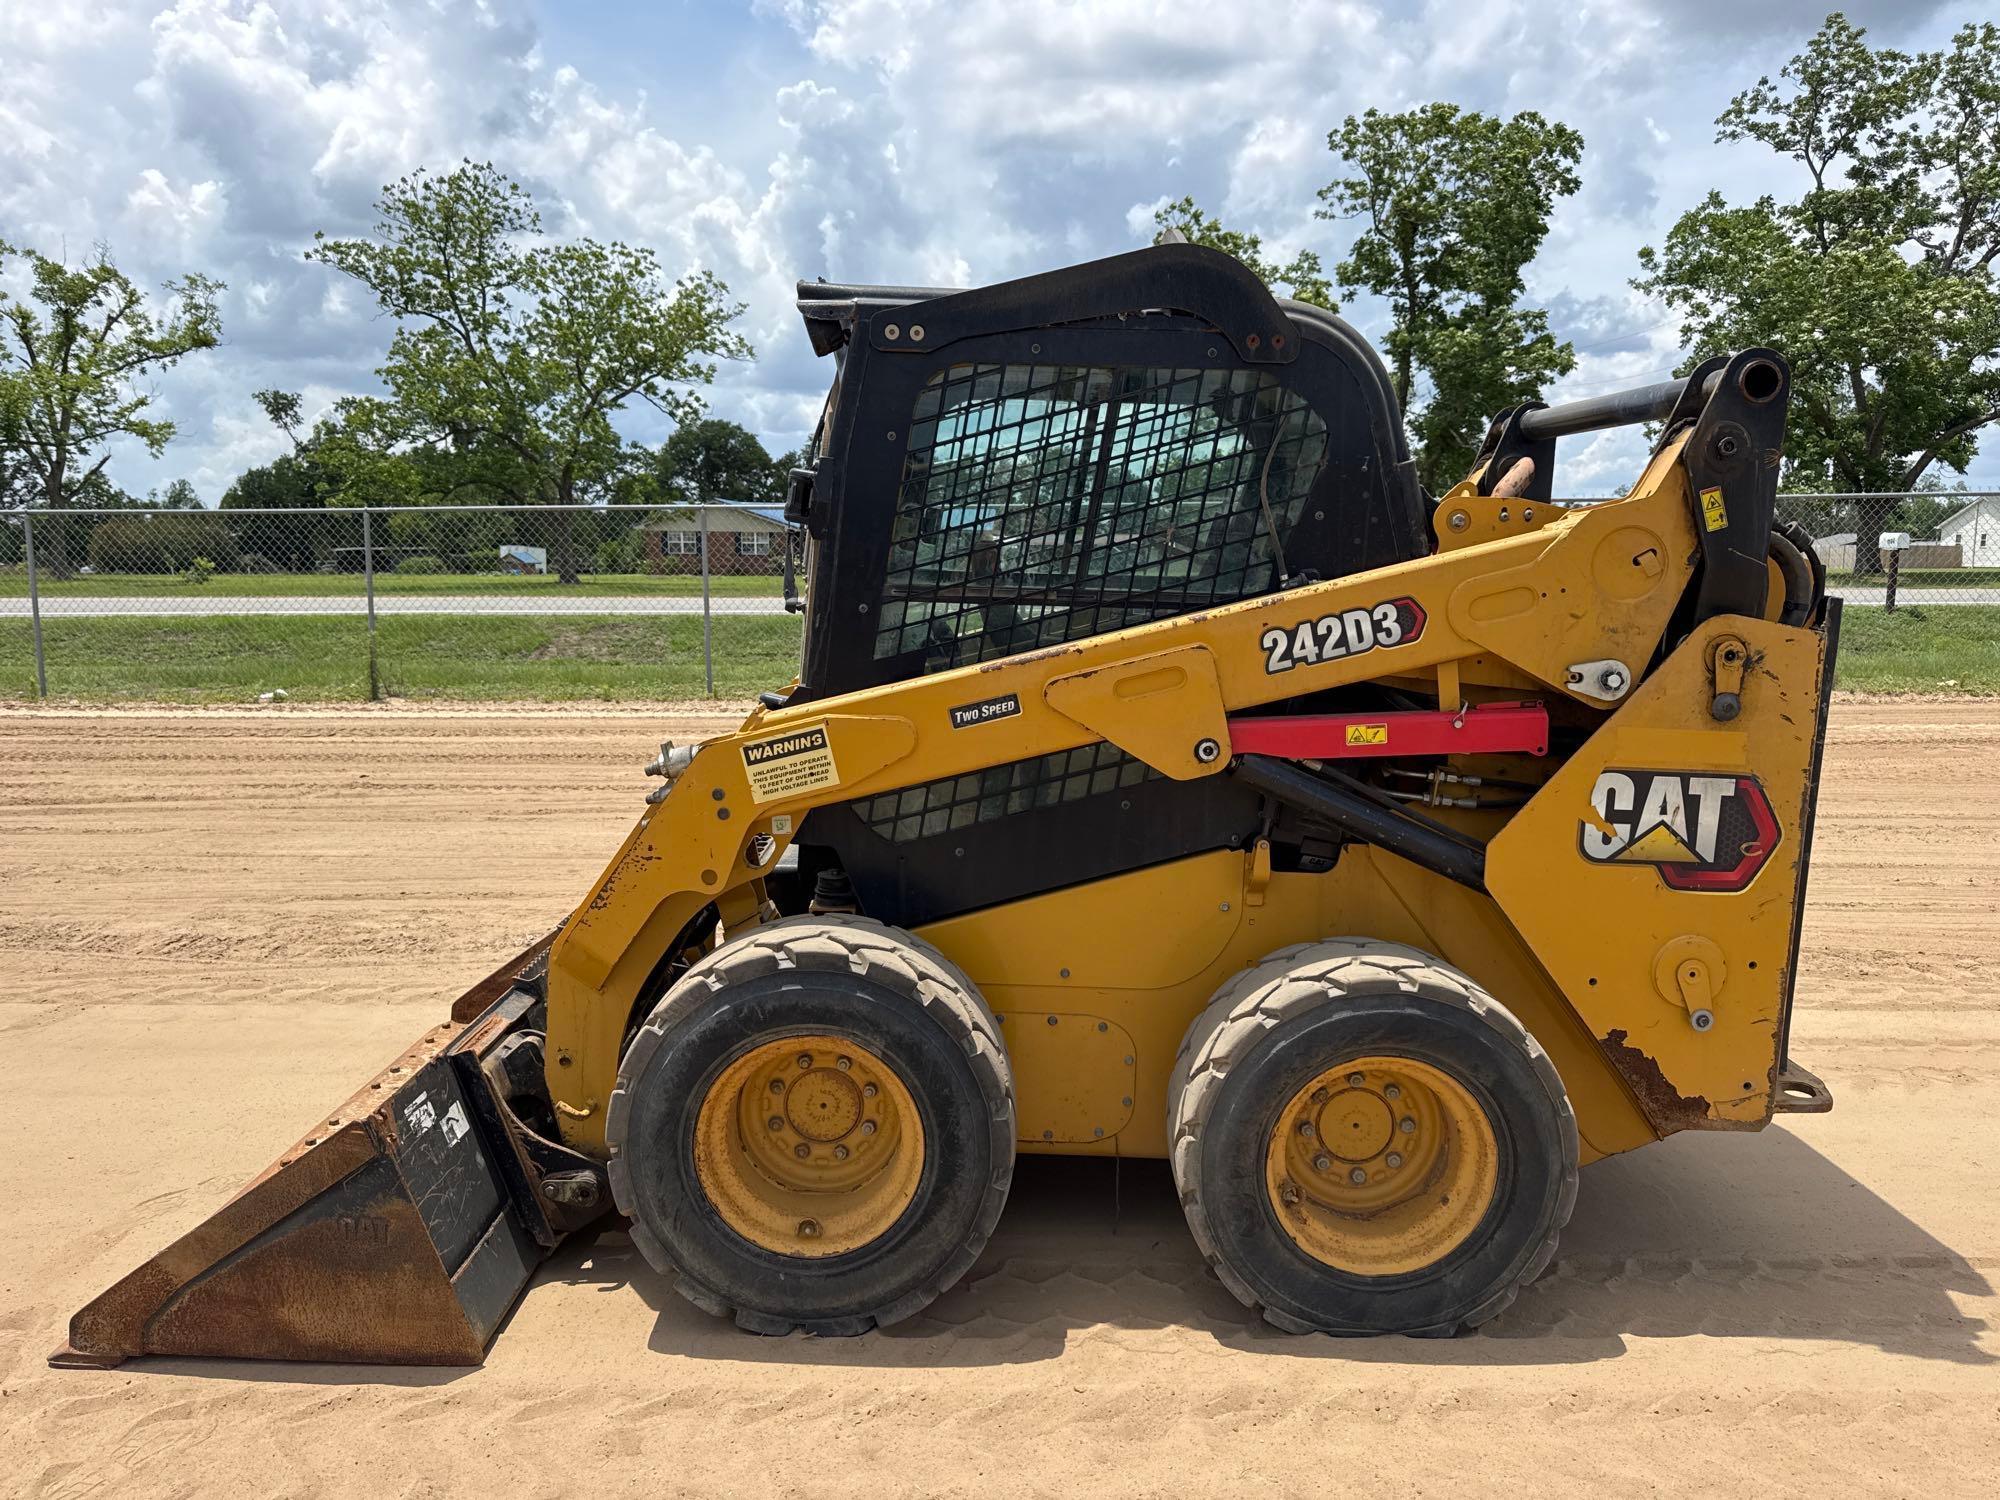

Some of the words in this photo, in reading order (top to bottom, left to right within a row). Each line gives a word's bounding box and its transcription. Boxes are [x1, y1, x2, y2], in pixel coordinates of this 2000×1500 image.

[1262, 603, 1402, 672] 242D3
[748, 733, 823, 761] WARNING
[753, 765, 788, 777] UNLAWFUL
[799, 755, 828, 766] OPERATE
[753, 776, 768, 784] THIS
[769, 767, 807, 780] EQUIPMENT
[808, 761, 831, 771] WITHIN
[762, 787, 779, 796] HIGH
[780, 779, 809, 791] VOLTAGE
[810, 776, 829, 784] LINES
[768, 779, 784, 787] FEET
[1583, 772, 1736, 863] CAT
